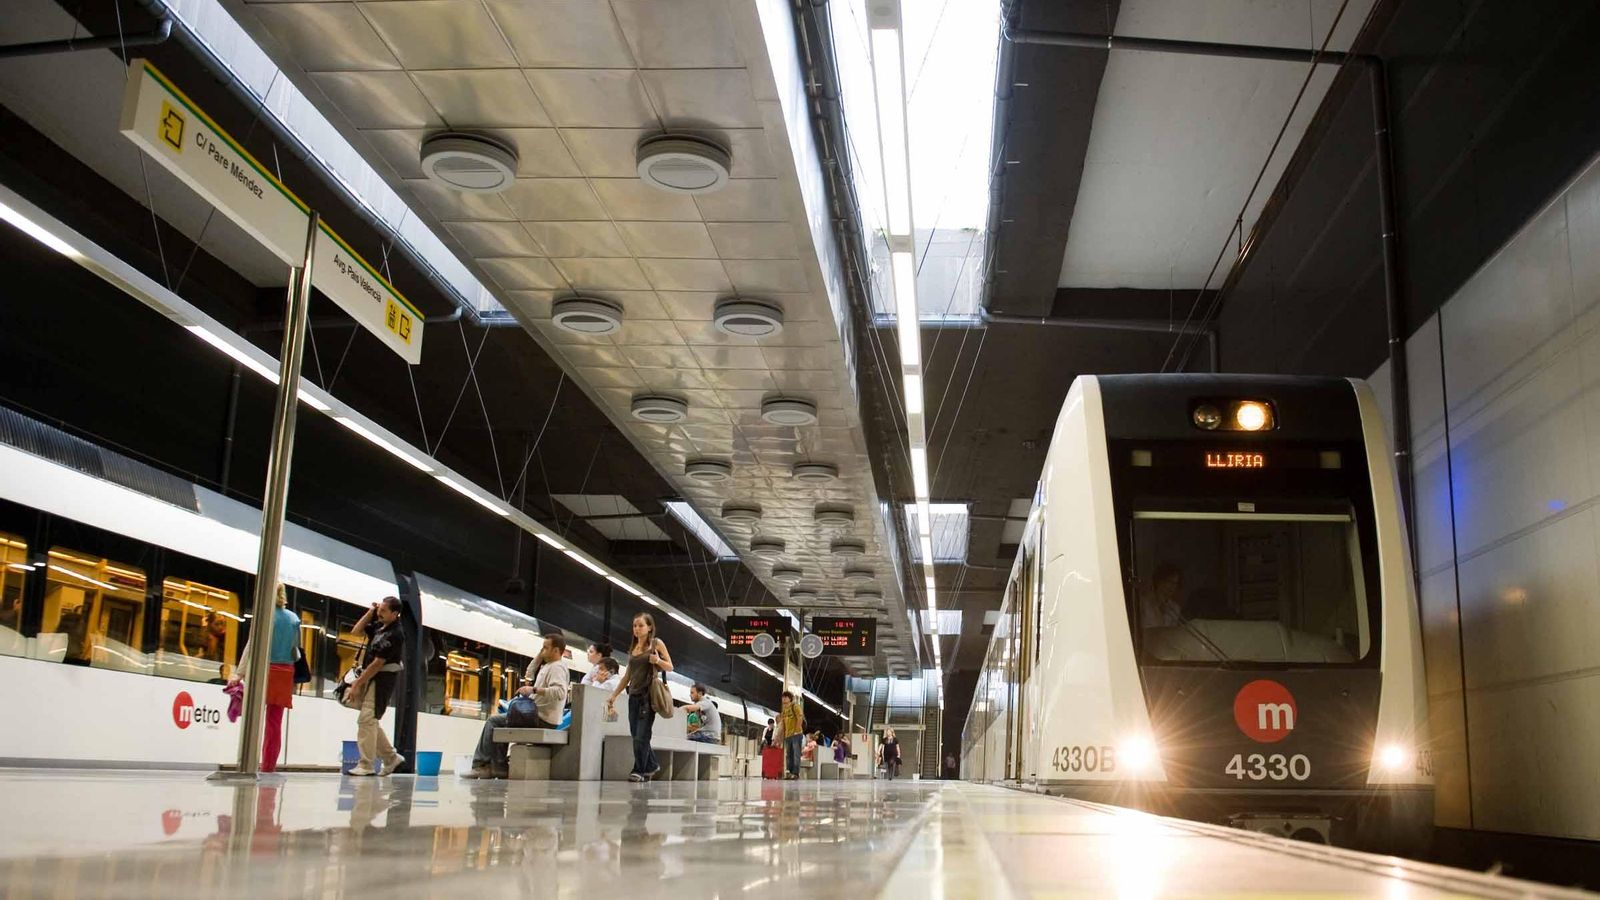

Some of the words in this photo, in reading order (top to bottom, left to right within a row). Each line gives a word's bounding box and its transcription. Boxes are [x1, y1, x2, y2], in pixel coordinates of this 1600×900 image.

[195, 132, 208, 150] C/
[208, 143, 229, 169] Pare
[230, 163, 264, 199] Méndez
[1207, 454, 1263, 468] LLIRIA
[807, 643, 816, 655] 2
[179, 705, 221, 724] metro
[1258, 703, 1294, 730] m
[1052, 745, 1117, 773] 4330B
[1225, 753, 1311, 781] 4330
